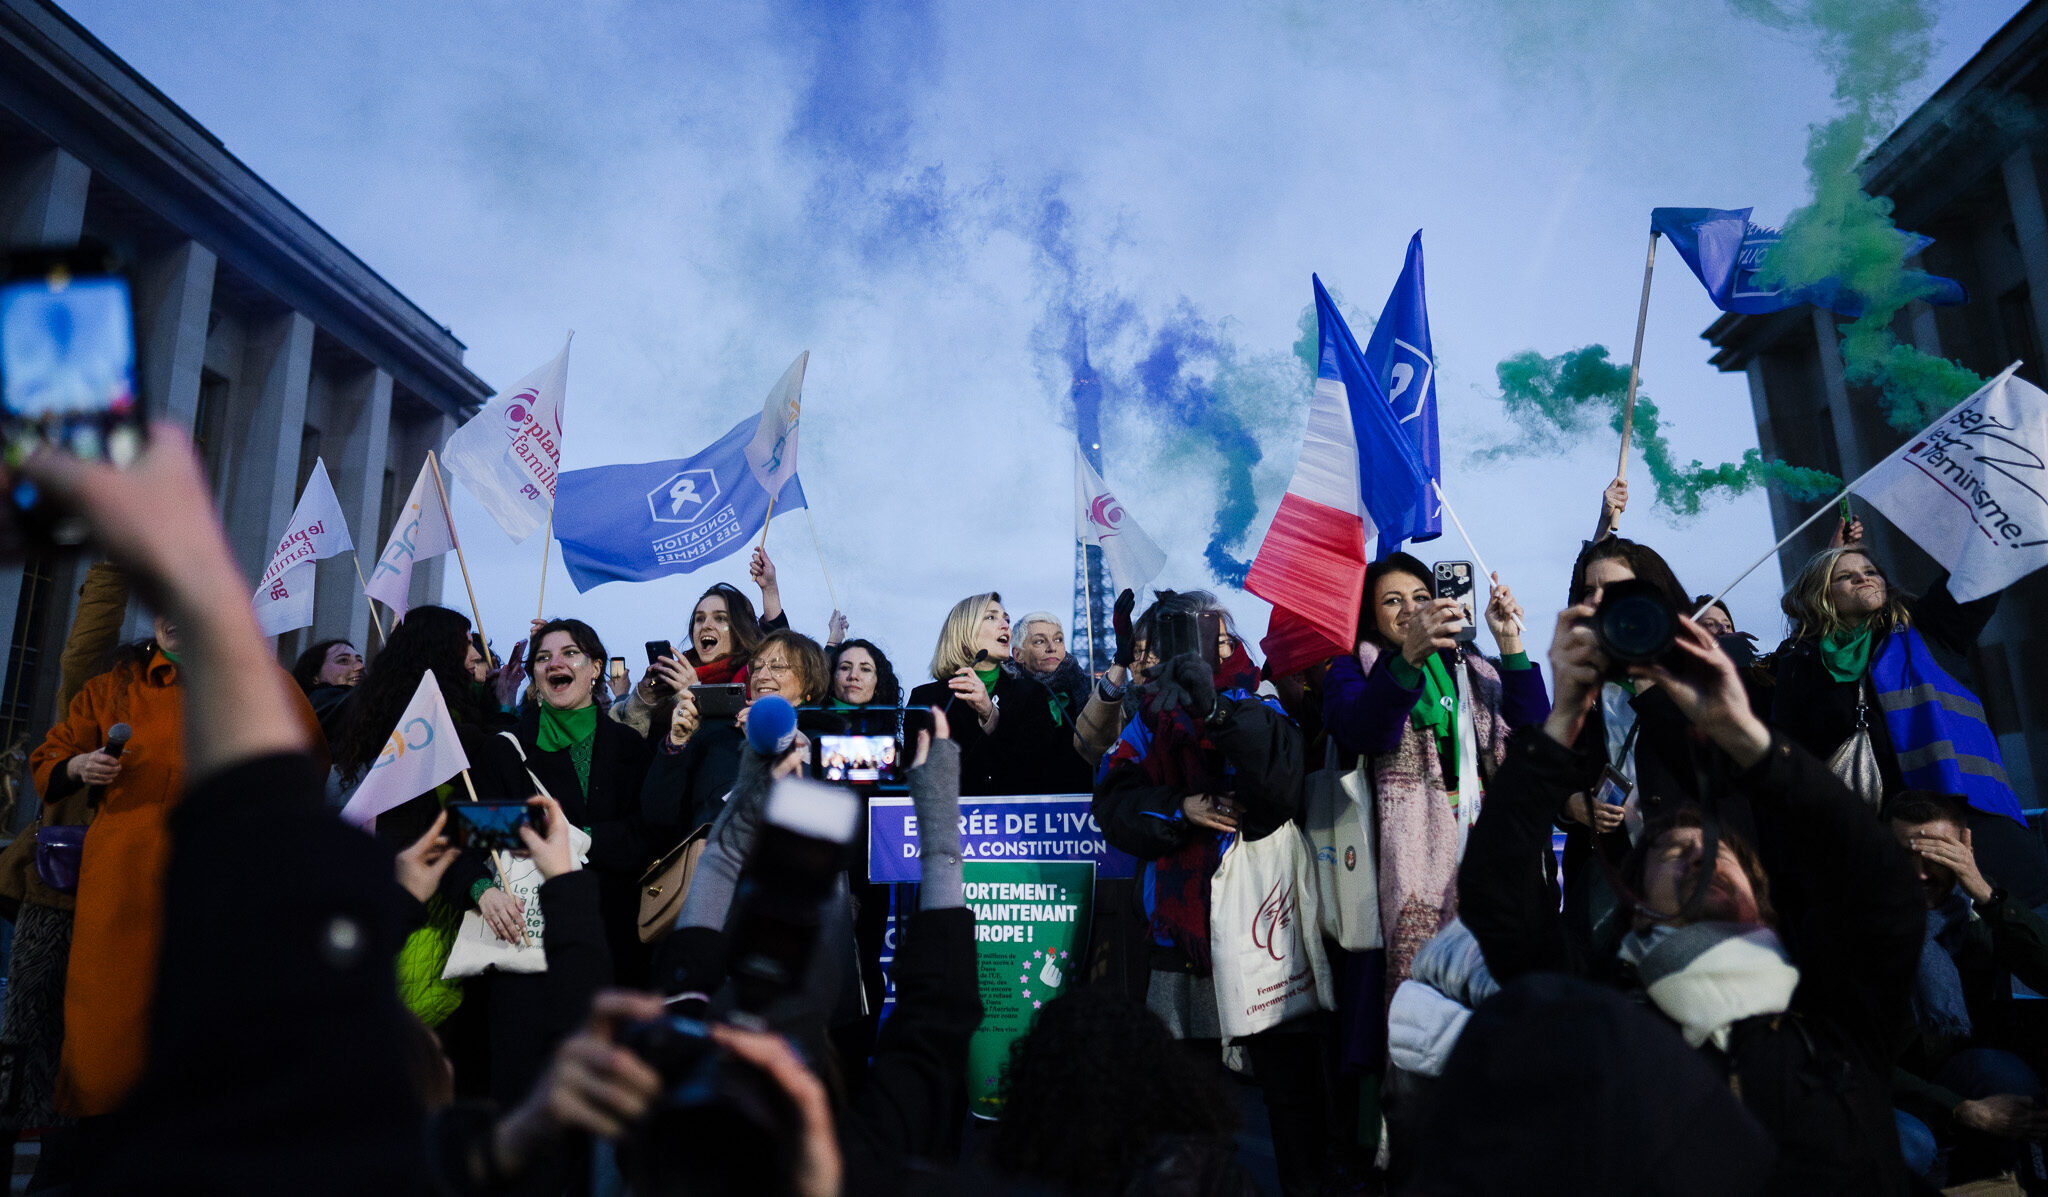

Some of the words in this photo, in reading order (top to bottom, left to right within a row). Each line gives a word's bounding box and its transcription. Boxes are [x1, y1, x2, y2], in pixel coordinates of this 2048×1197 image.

[904, 809, 998, 837] ERÉE
[1005, 813, 1037, 835] DE
[979, 840, 1107, 857] CONSTITUTION
[1256, 978, 1289, 996] Femmes
[1246, 992, 1289, 1016] Citoyennes
